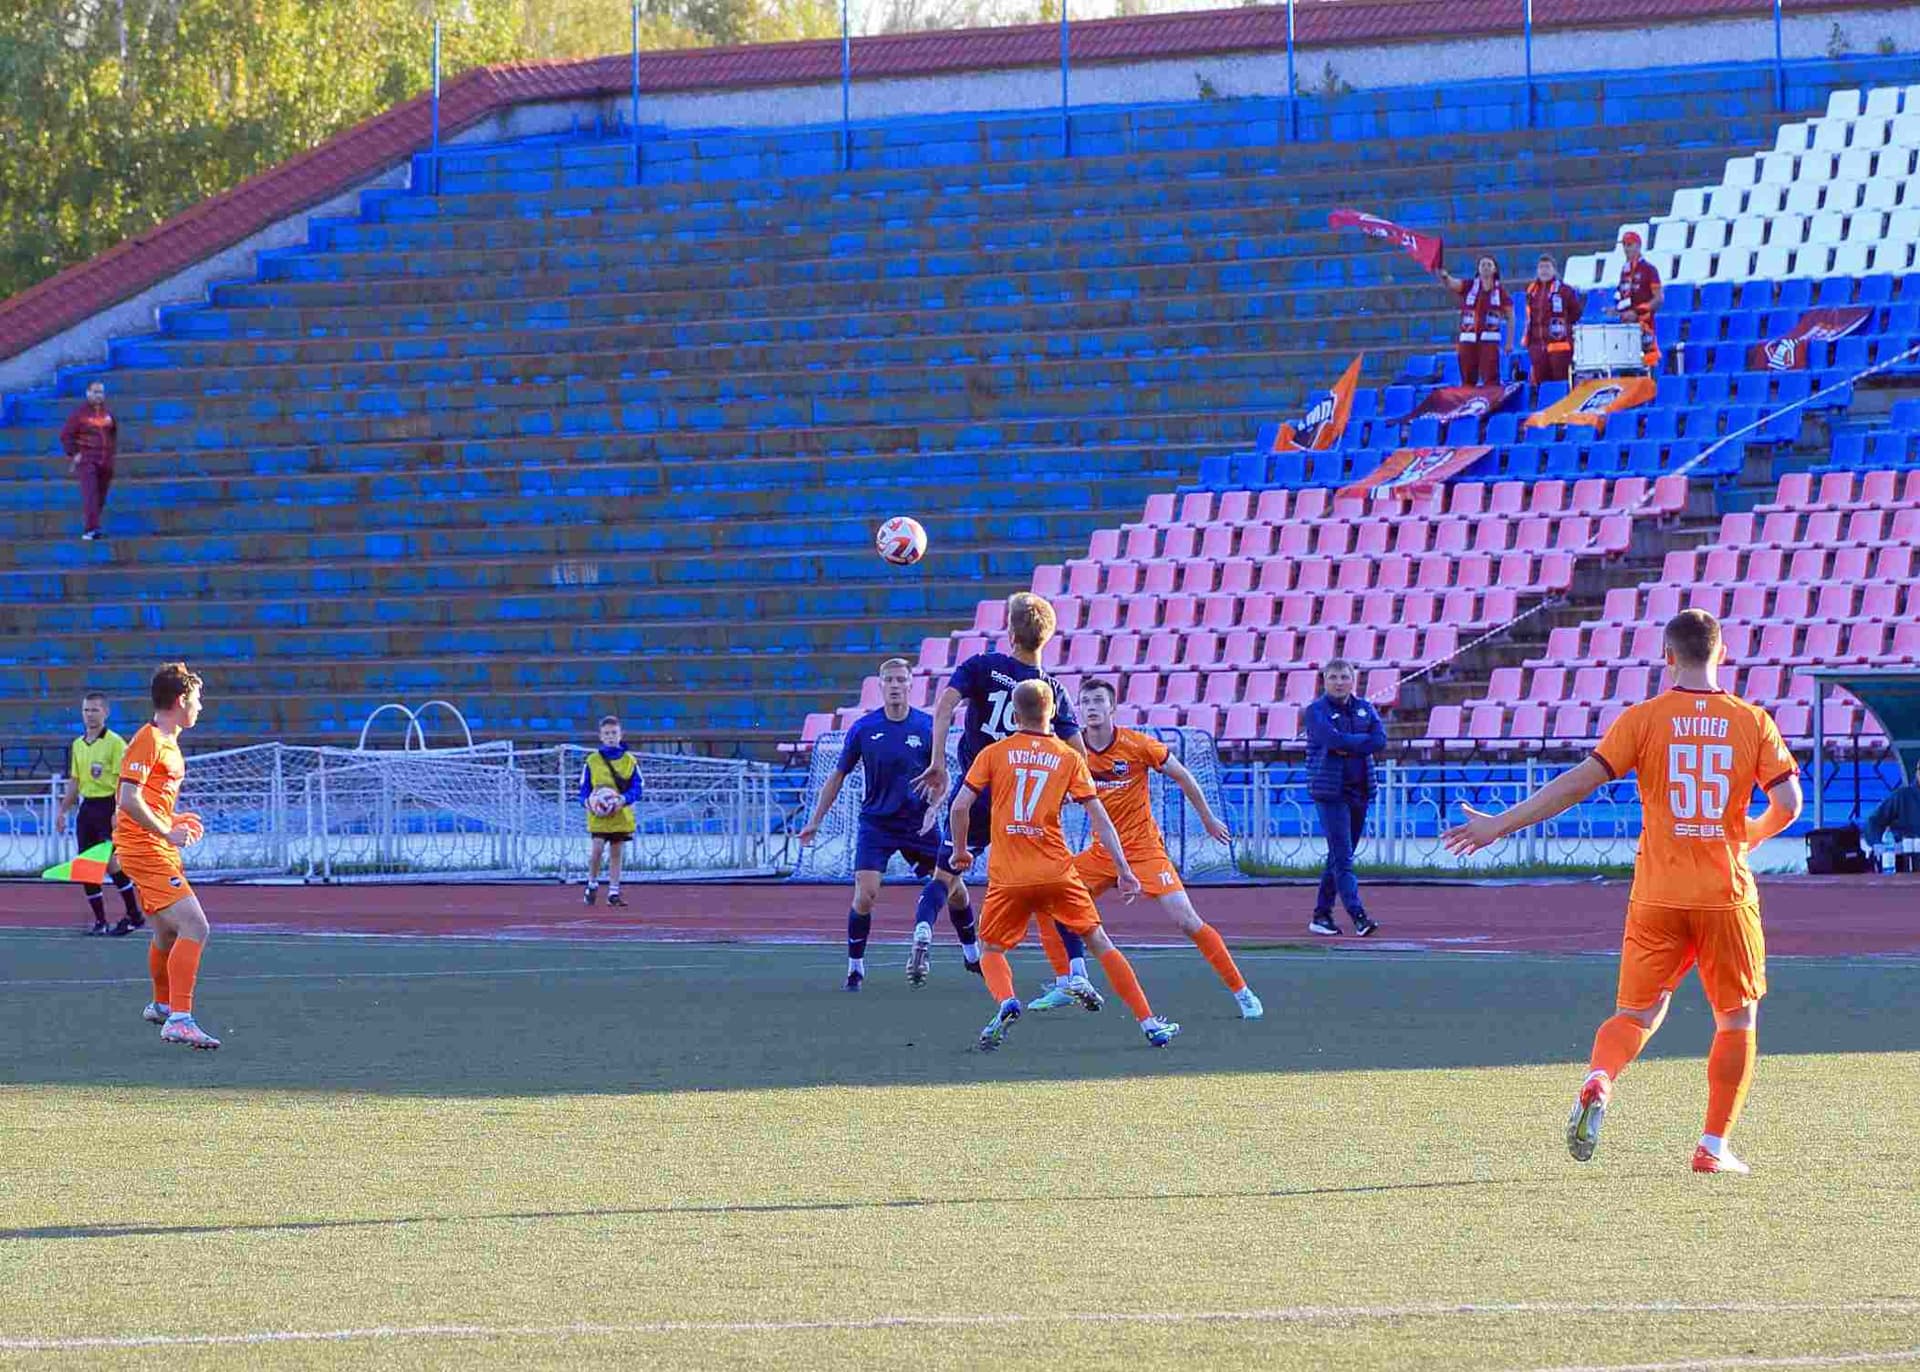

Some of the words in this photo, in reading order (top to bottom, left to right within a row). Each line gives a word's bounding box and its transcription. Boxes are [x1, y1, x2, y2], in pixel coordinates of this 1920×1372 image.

[1672, 716, 1729, 738] ХУГАЕВ
[1014, 767, 1049, 823] 17
[1668, 743, 1733, 819] 55
